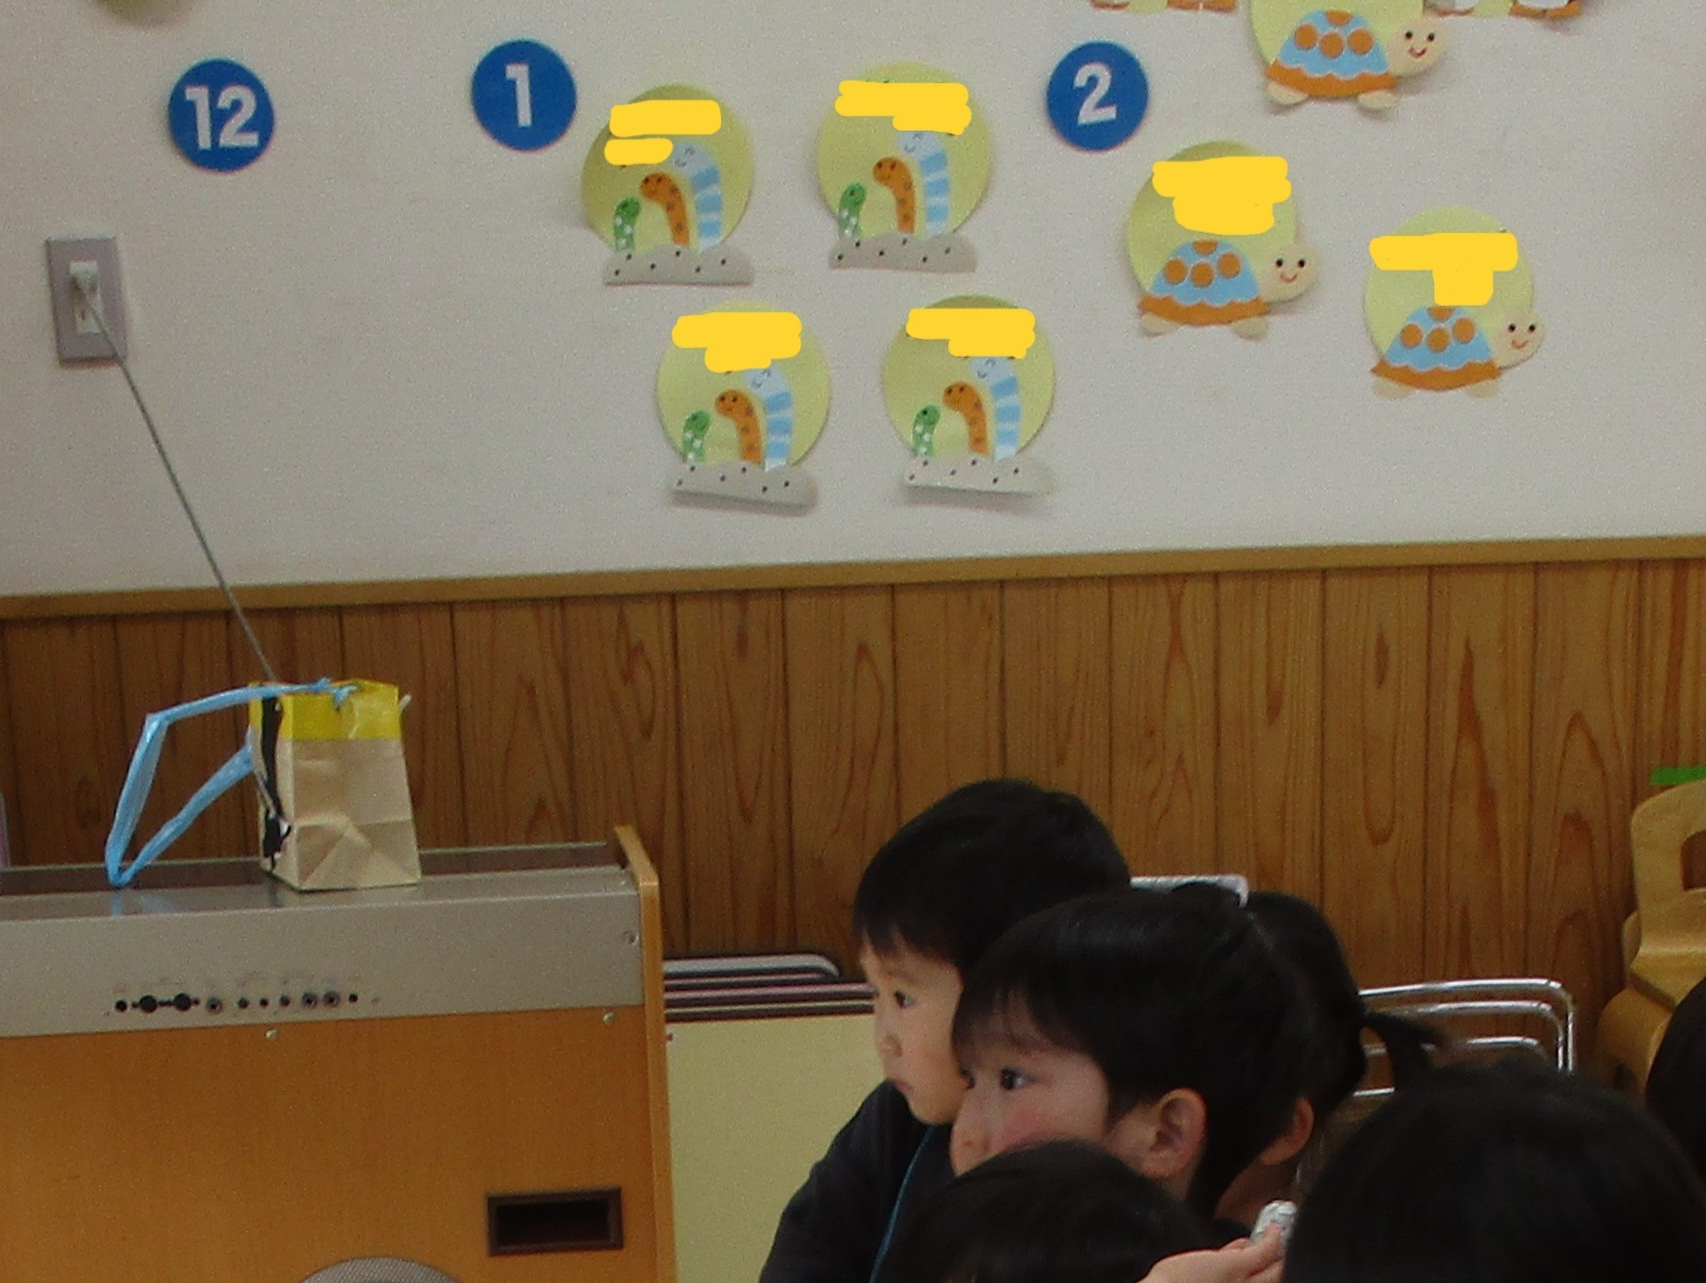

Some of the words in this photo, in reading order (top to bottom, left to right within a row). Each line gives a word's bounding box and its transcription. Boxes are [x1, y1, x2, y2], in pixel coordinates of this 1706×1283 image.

[185, 85, 260, 151] 12
[504, 63, 533, 128] 1
[1073, 61, 1118, 126] 2
